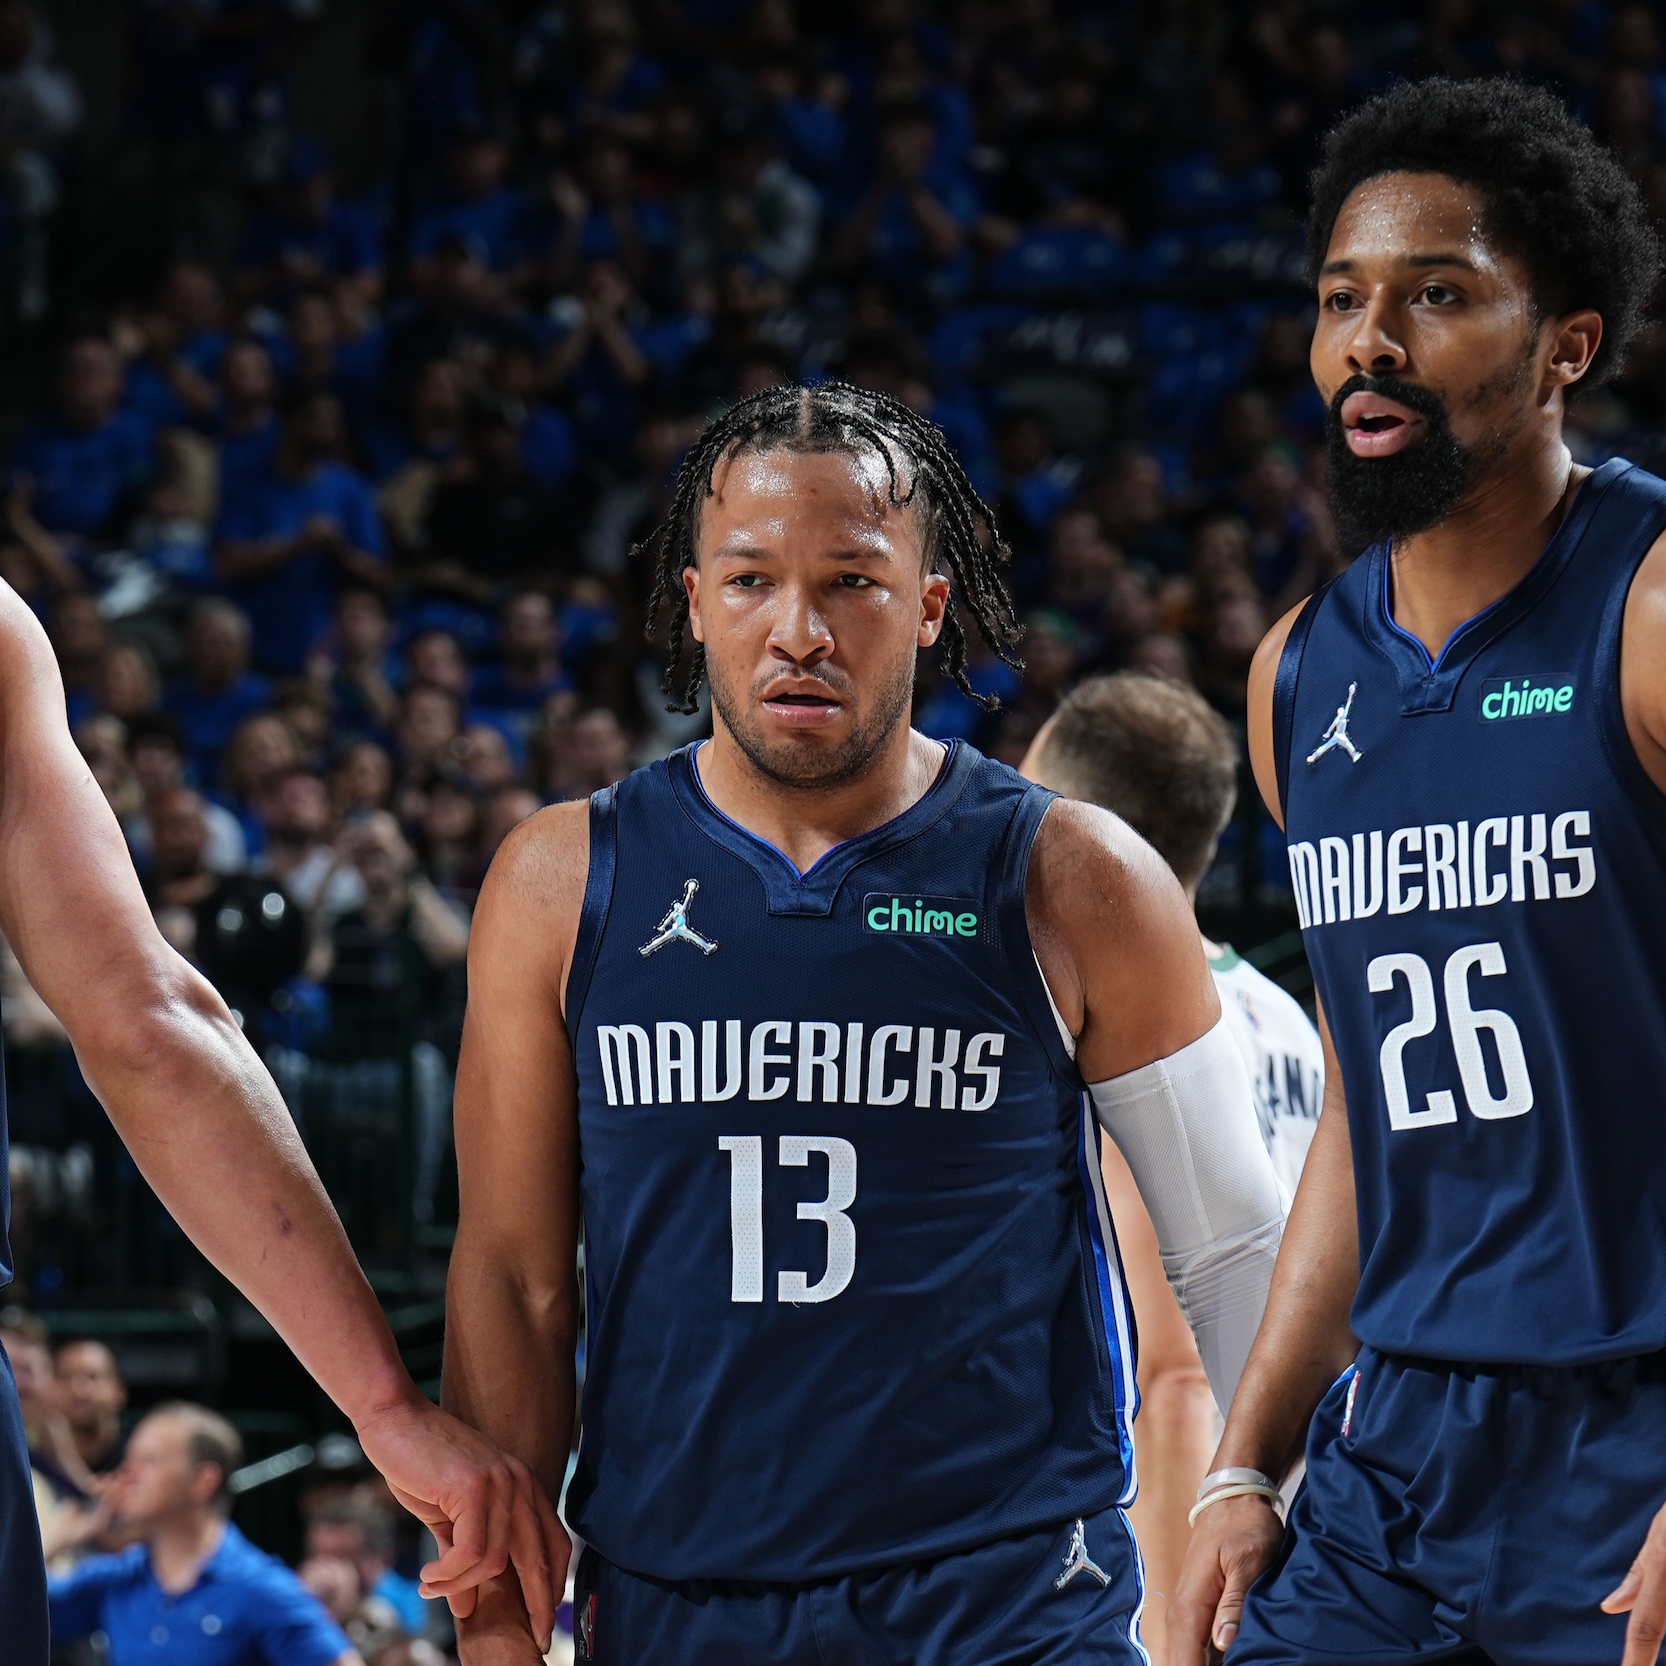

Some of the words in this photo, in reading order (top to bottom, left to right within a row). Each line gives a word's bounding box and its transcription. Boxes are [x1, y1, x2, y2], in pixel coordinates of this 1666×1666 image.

[1482, 680, 1574, 720] chime
[867, 898, 978, 937] chime
[1288, 810, 1596, 930] MAVERICKS
[596, 1019, 1006, 1112] MAVERICKS
[1367, 941, 1534, 1132] 26
[717, 1135, 858, 1303] 13
